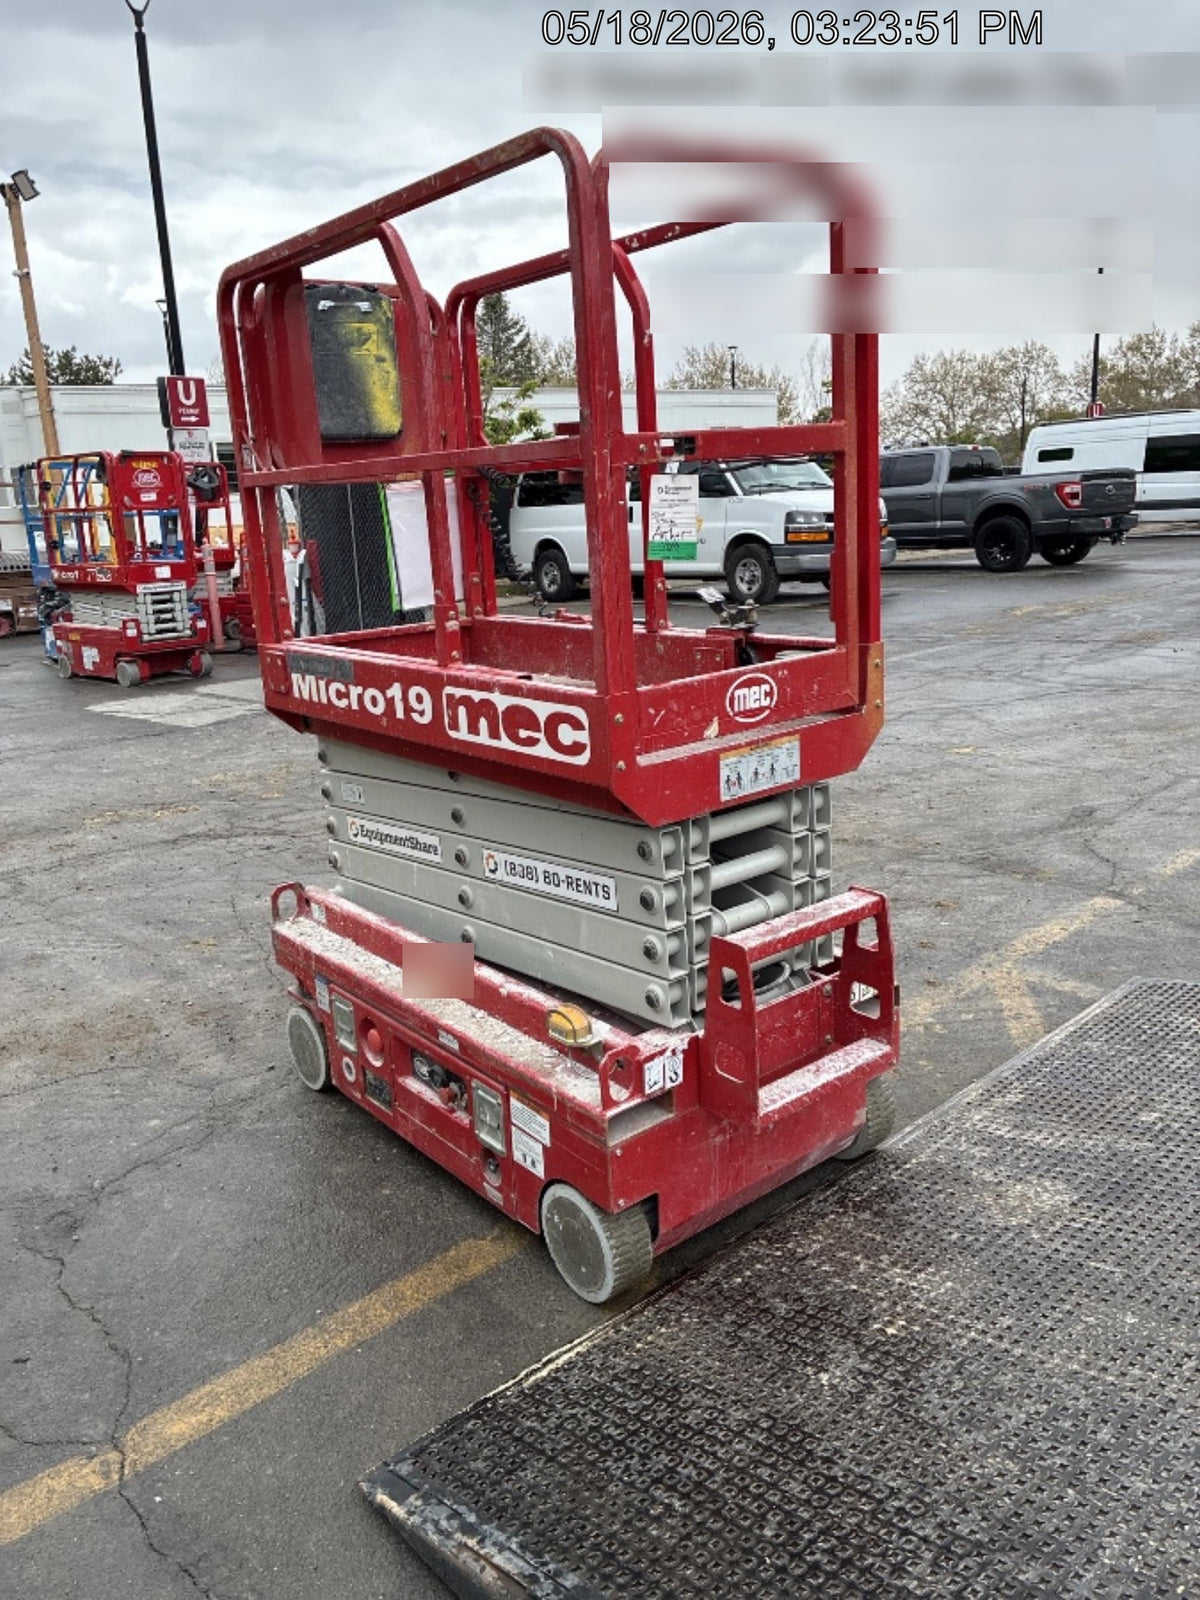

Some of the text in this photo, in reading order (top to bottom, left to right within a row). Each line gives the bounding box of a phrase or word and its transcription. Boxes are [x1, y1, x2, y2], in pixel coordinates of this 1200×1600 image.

[177, 380, 196, 406] U
[290, 672, 433, 724] Micro19
[360, 825, 439, 855] EquipmentShare
